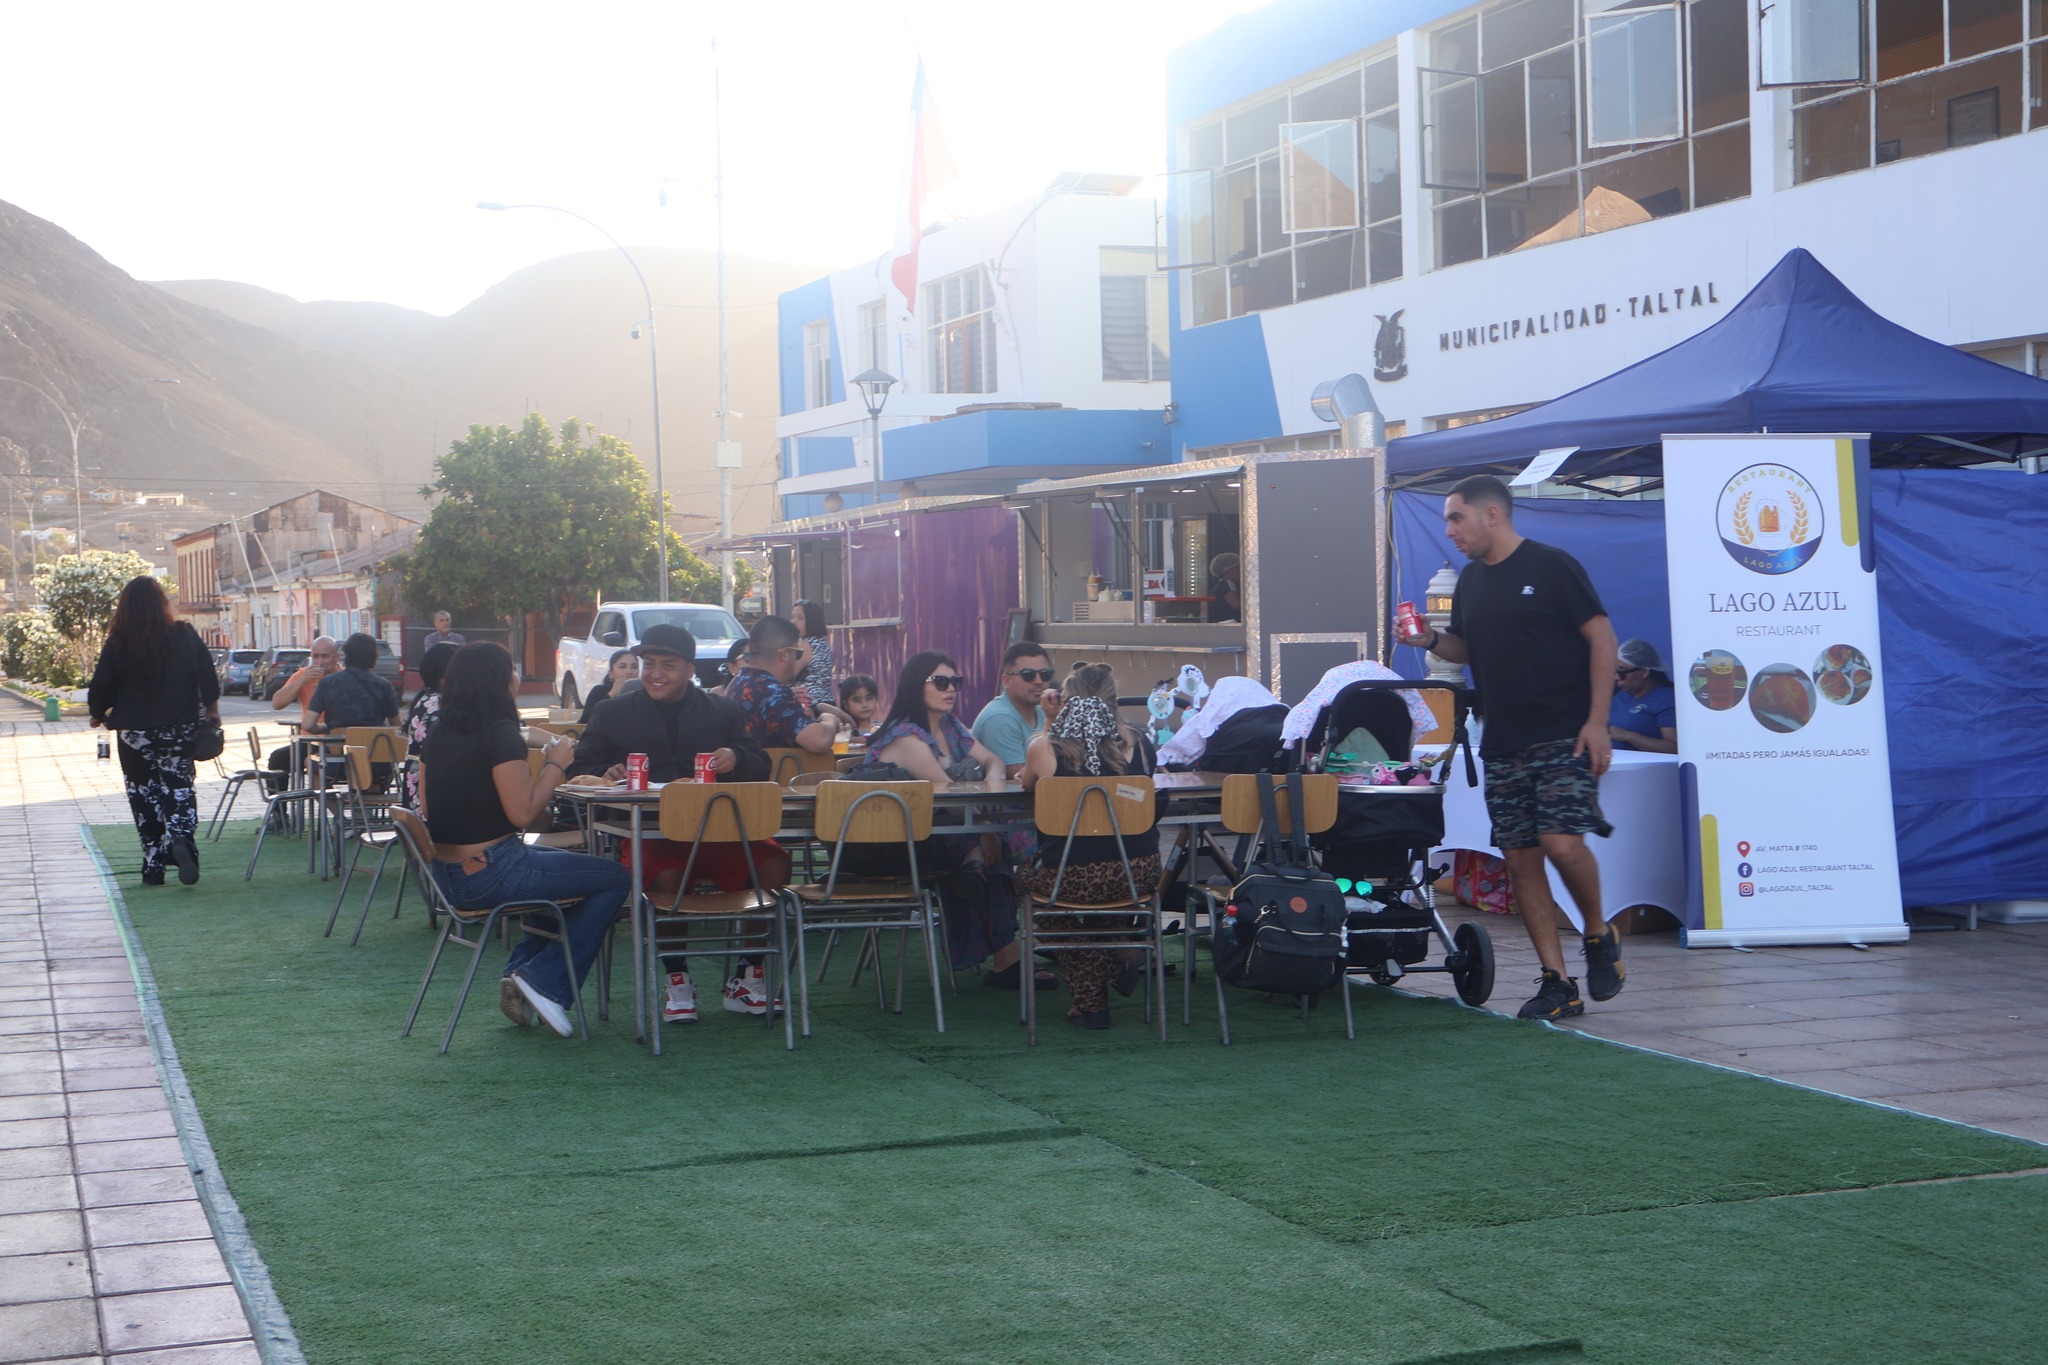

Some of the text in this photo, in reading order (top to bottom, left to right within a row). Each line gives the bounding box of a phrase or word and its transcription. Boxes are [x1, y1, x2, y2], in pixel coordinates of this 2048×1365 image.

[1439, 282, 1720, 352] MUNICIPALIDAD TALTAL
[1727, 469, 1813, 495] RESTAURANT
[1743, 556, 1773, 569] LAGO
[1708, 591, 1847, 613] LAGO AZUL
[1736, 624, 1822, 637] RESTAURANT
[1752, 750, 1778, 759] PERO
[1813, 748, 1869, 758] IGUALADAS!
[1757, 863, 1874, 874] LAGO AZUL RESTAURANT TALTAL
